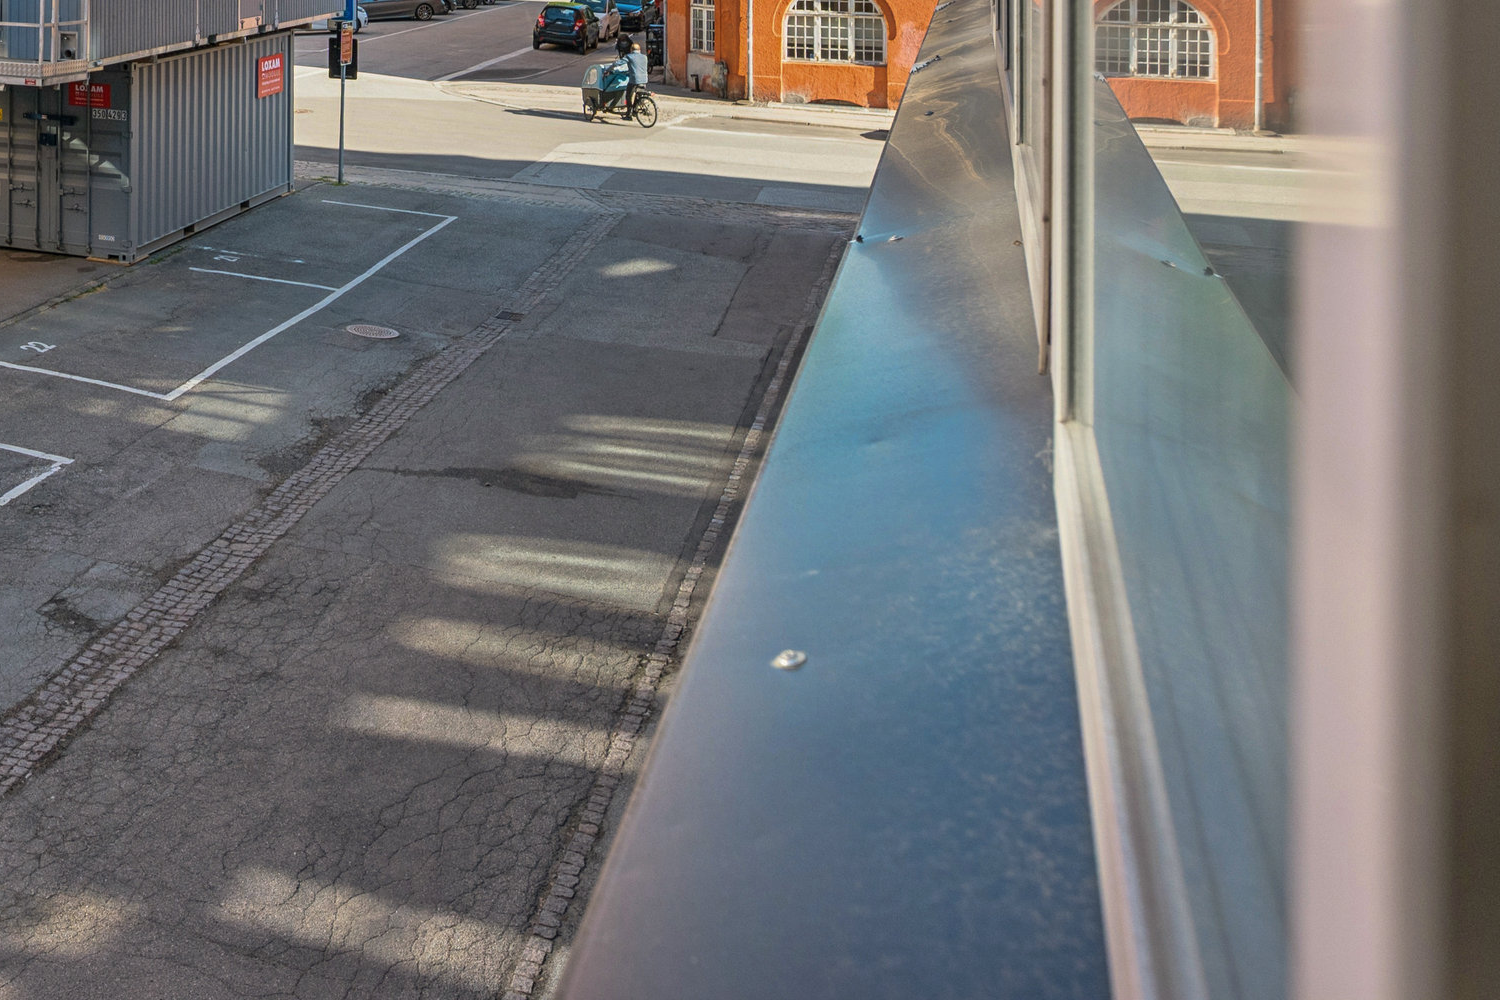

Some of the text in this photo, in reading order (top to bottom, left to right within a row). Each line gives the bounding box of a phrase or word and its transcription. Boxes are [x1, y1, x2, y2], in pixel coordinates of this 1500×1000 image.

[262, 58, 280, 71] LOXAM
[75, 84, 104, 93] LOAM
[20, 341, 57, 353] 22
